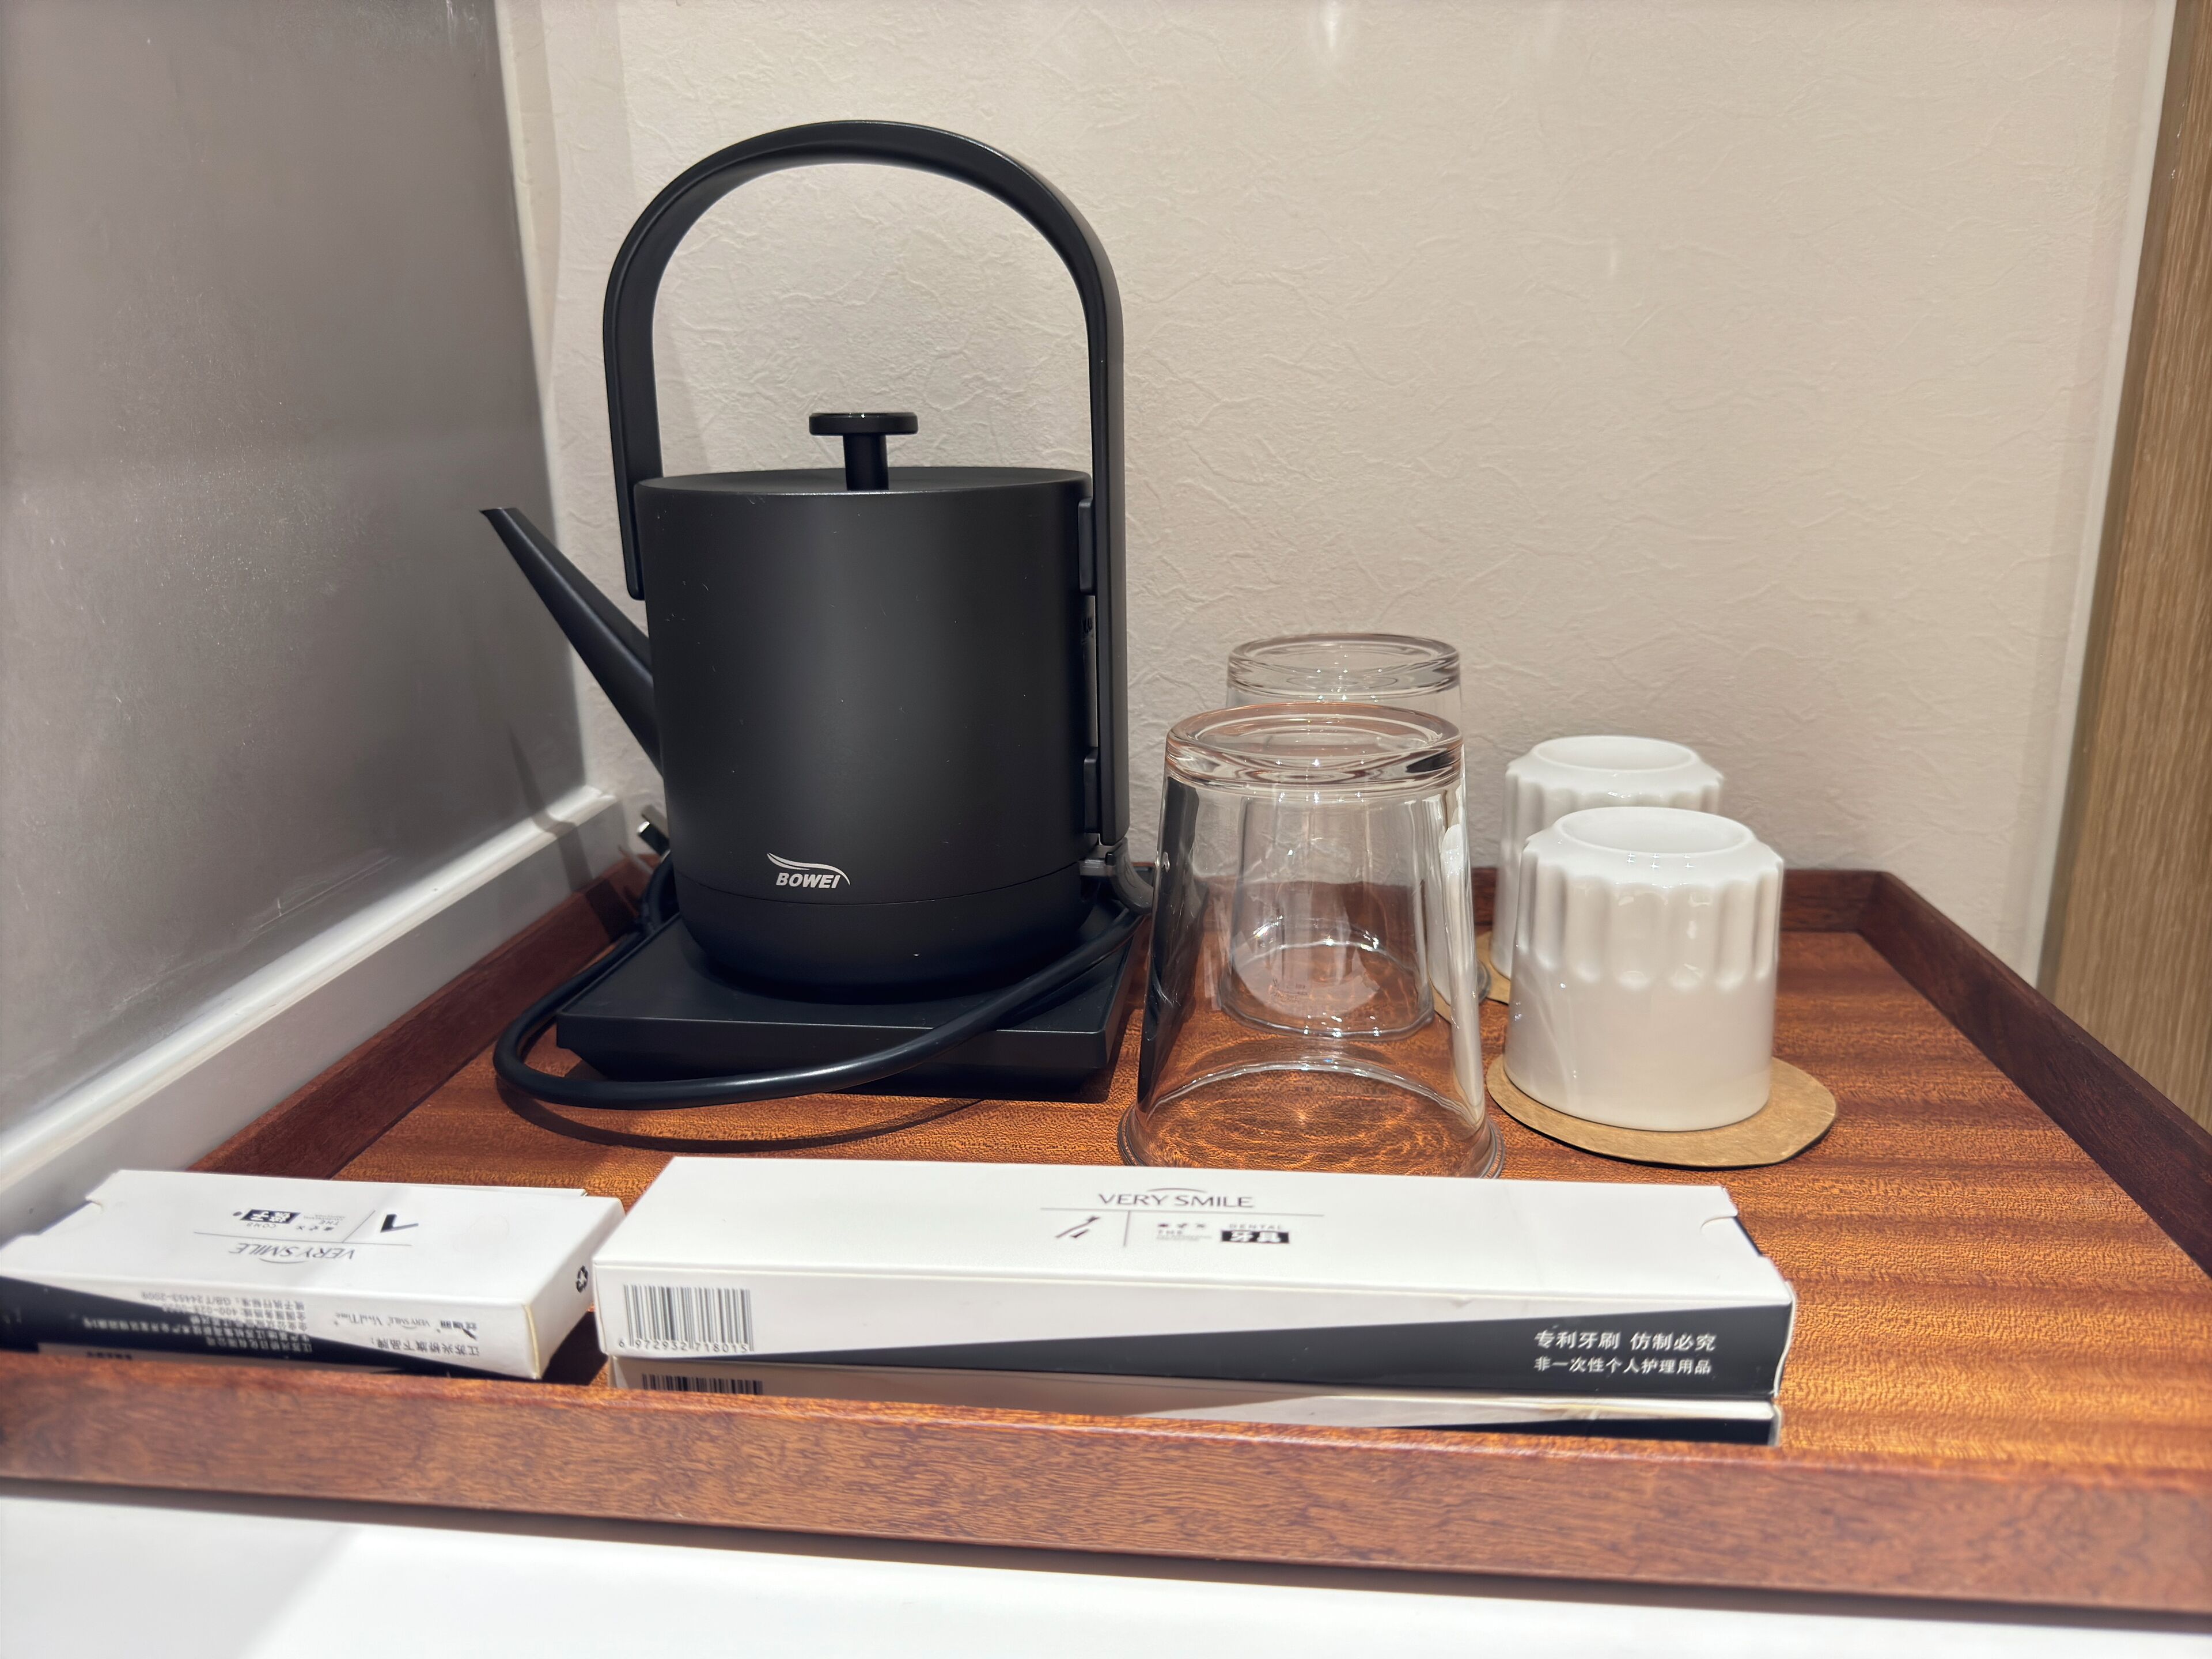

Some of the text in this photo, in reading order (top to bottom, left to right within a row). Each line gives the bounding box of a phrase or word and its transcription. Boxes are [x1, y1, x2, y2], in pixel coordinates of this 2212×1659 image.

[776, 872, 841, 889] BOWEI
[1099, 1193, 1255, 1209] VERY SMILE
[1230, 1230, 1282, 1243] 牙具
[228, 1242, 355, 1260] VERY SMILE
[619, 1340, 626, 1349] 6
[1533, 1330, 1717, 1351] 专利牙刷 仿制必究
[1533, 1355, 1713, 1375] 非一次性个人护理用品
